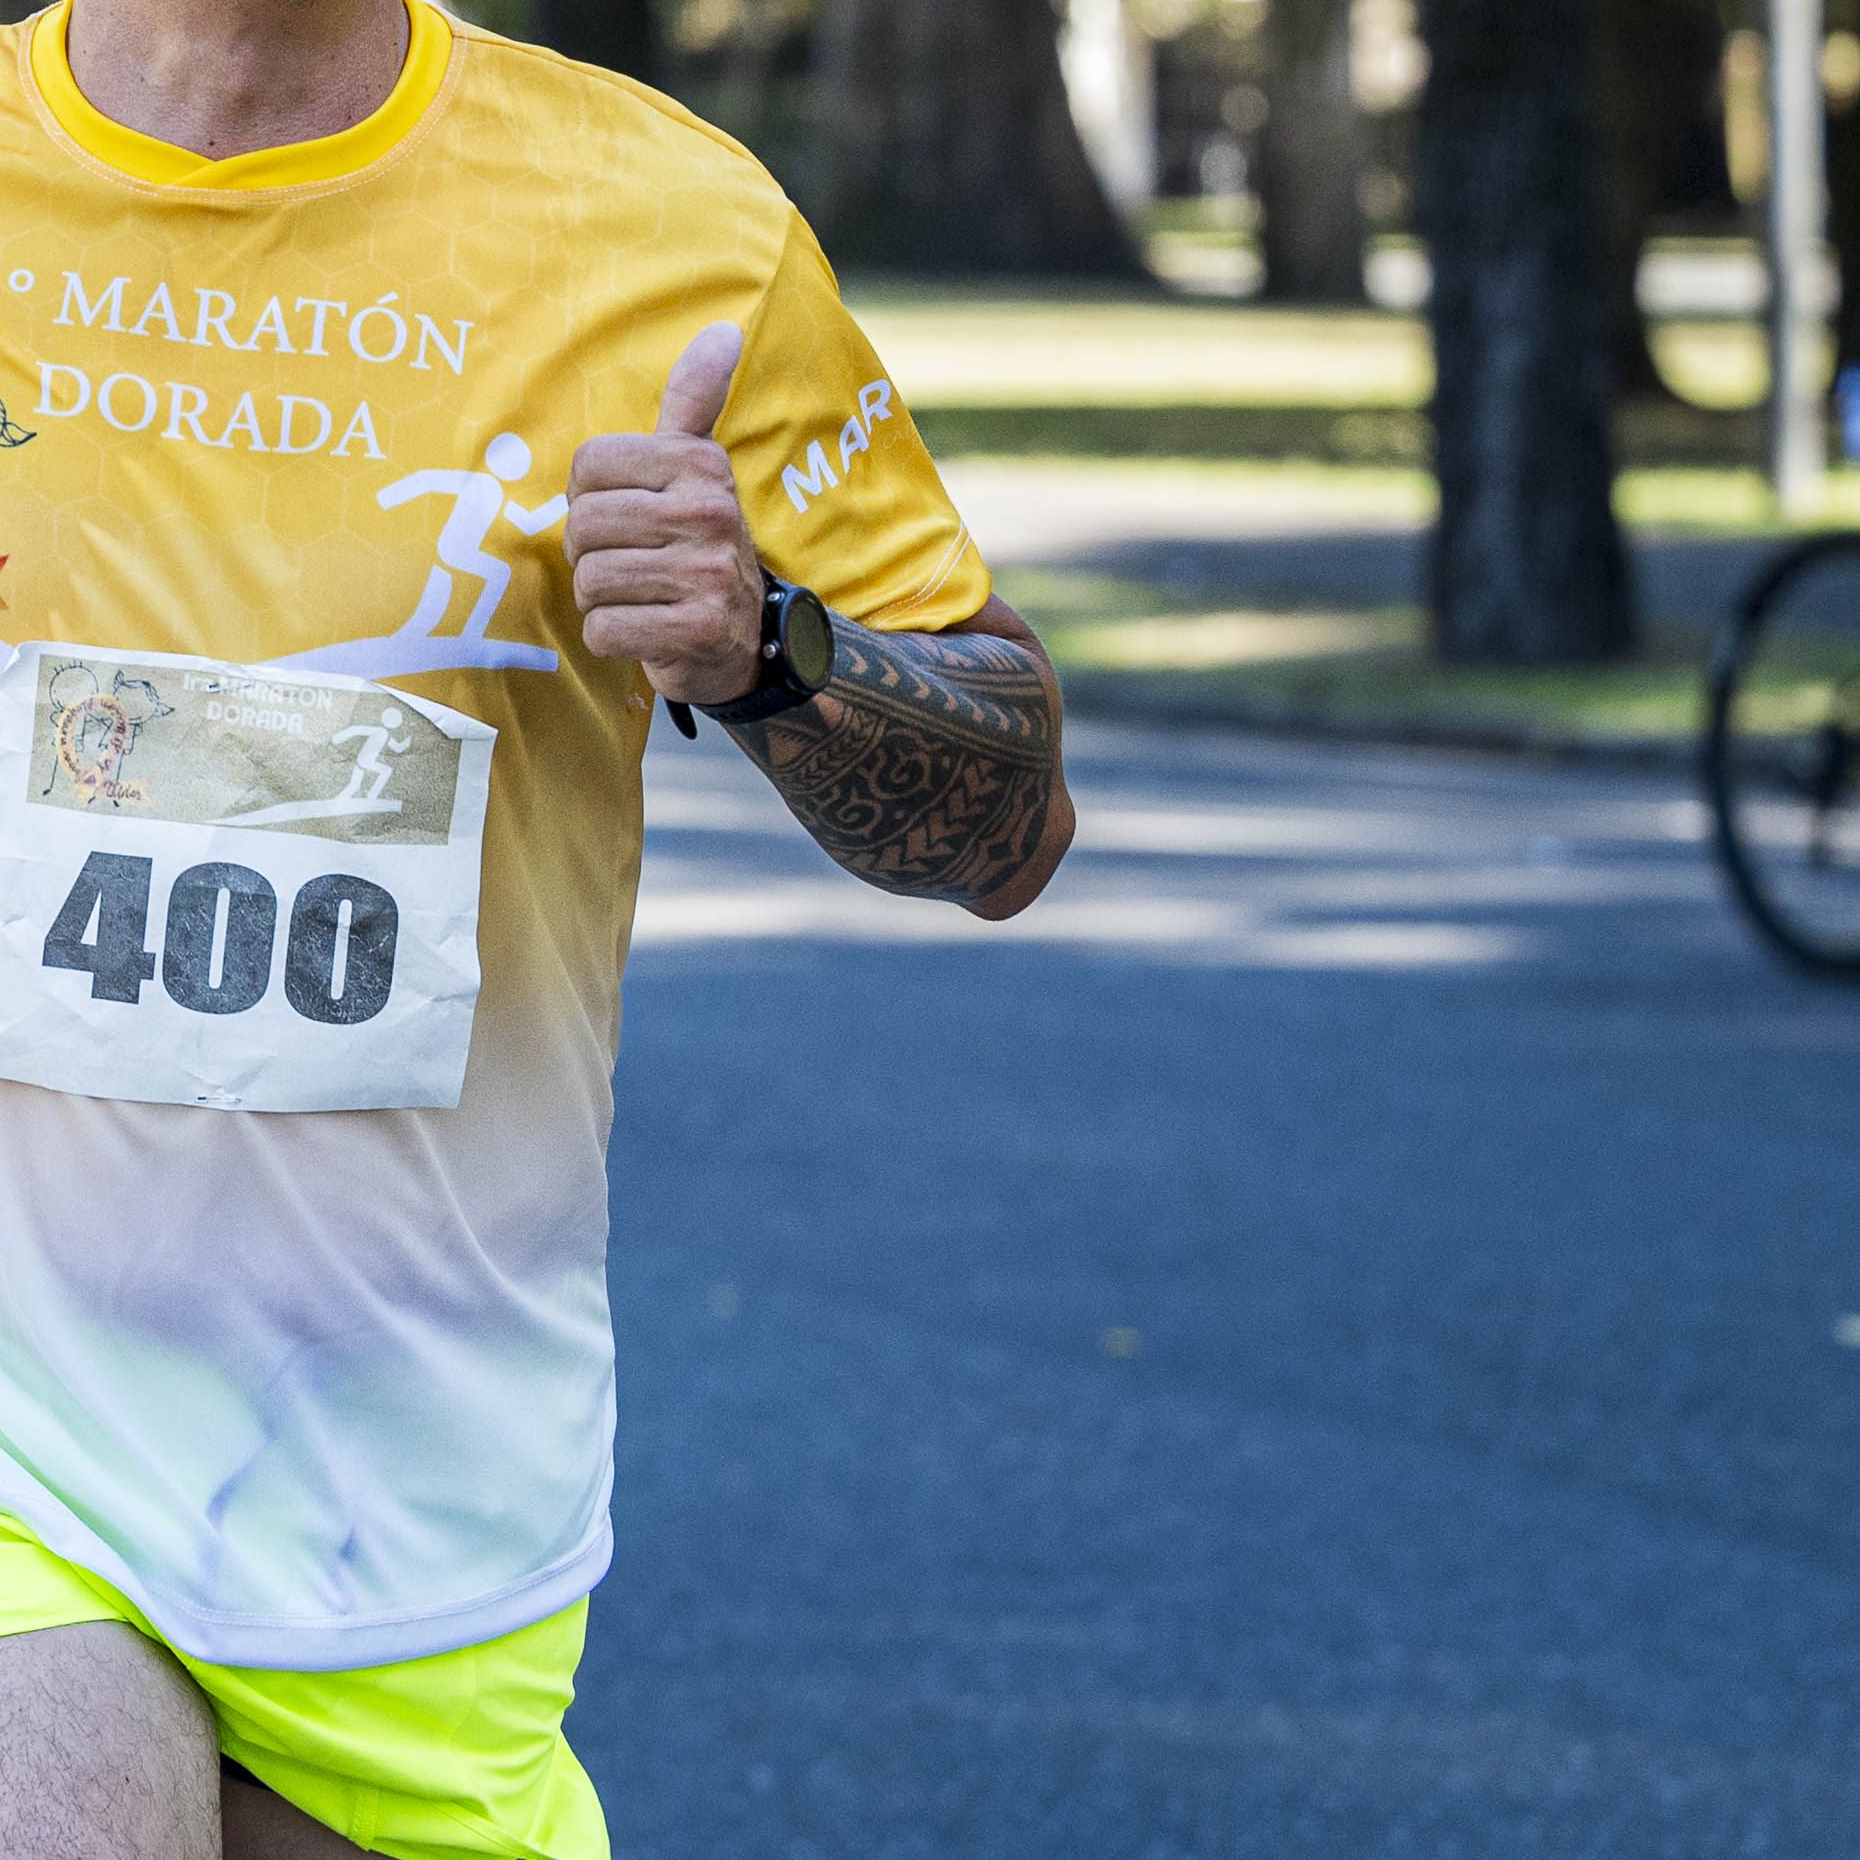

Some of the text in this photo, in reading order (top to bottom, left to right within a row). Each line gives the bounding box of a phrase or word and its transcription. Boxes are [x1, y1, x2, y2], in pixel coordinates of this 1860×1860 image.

[52, 270, 475, 375] MARATÓN
[33, 360, 386, 460] DORADA
[781, 379, 893, 514] MAR
[206, 700, 305, 734] DORADA
[42, 851, 399, 1025] 400
